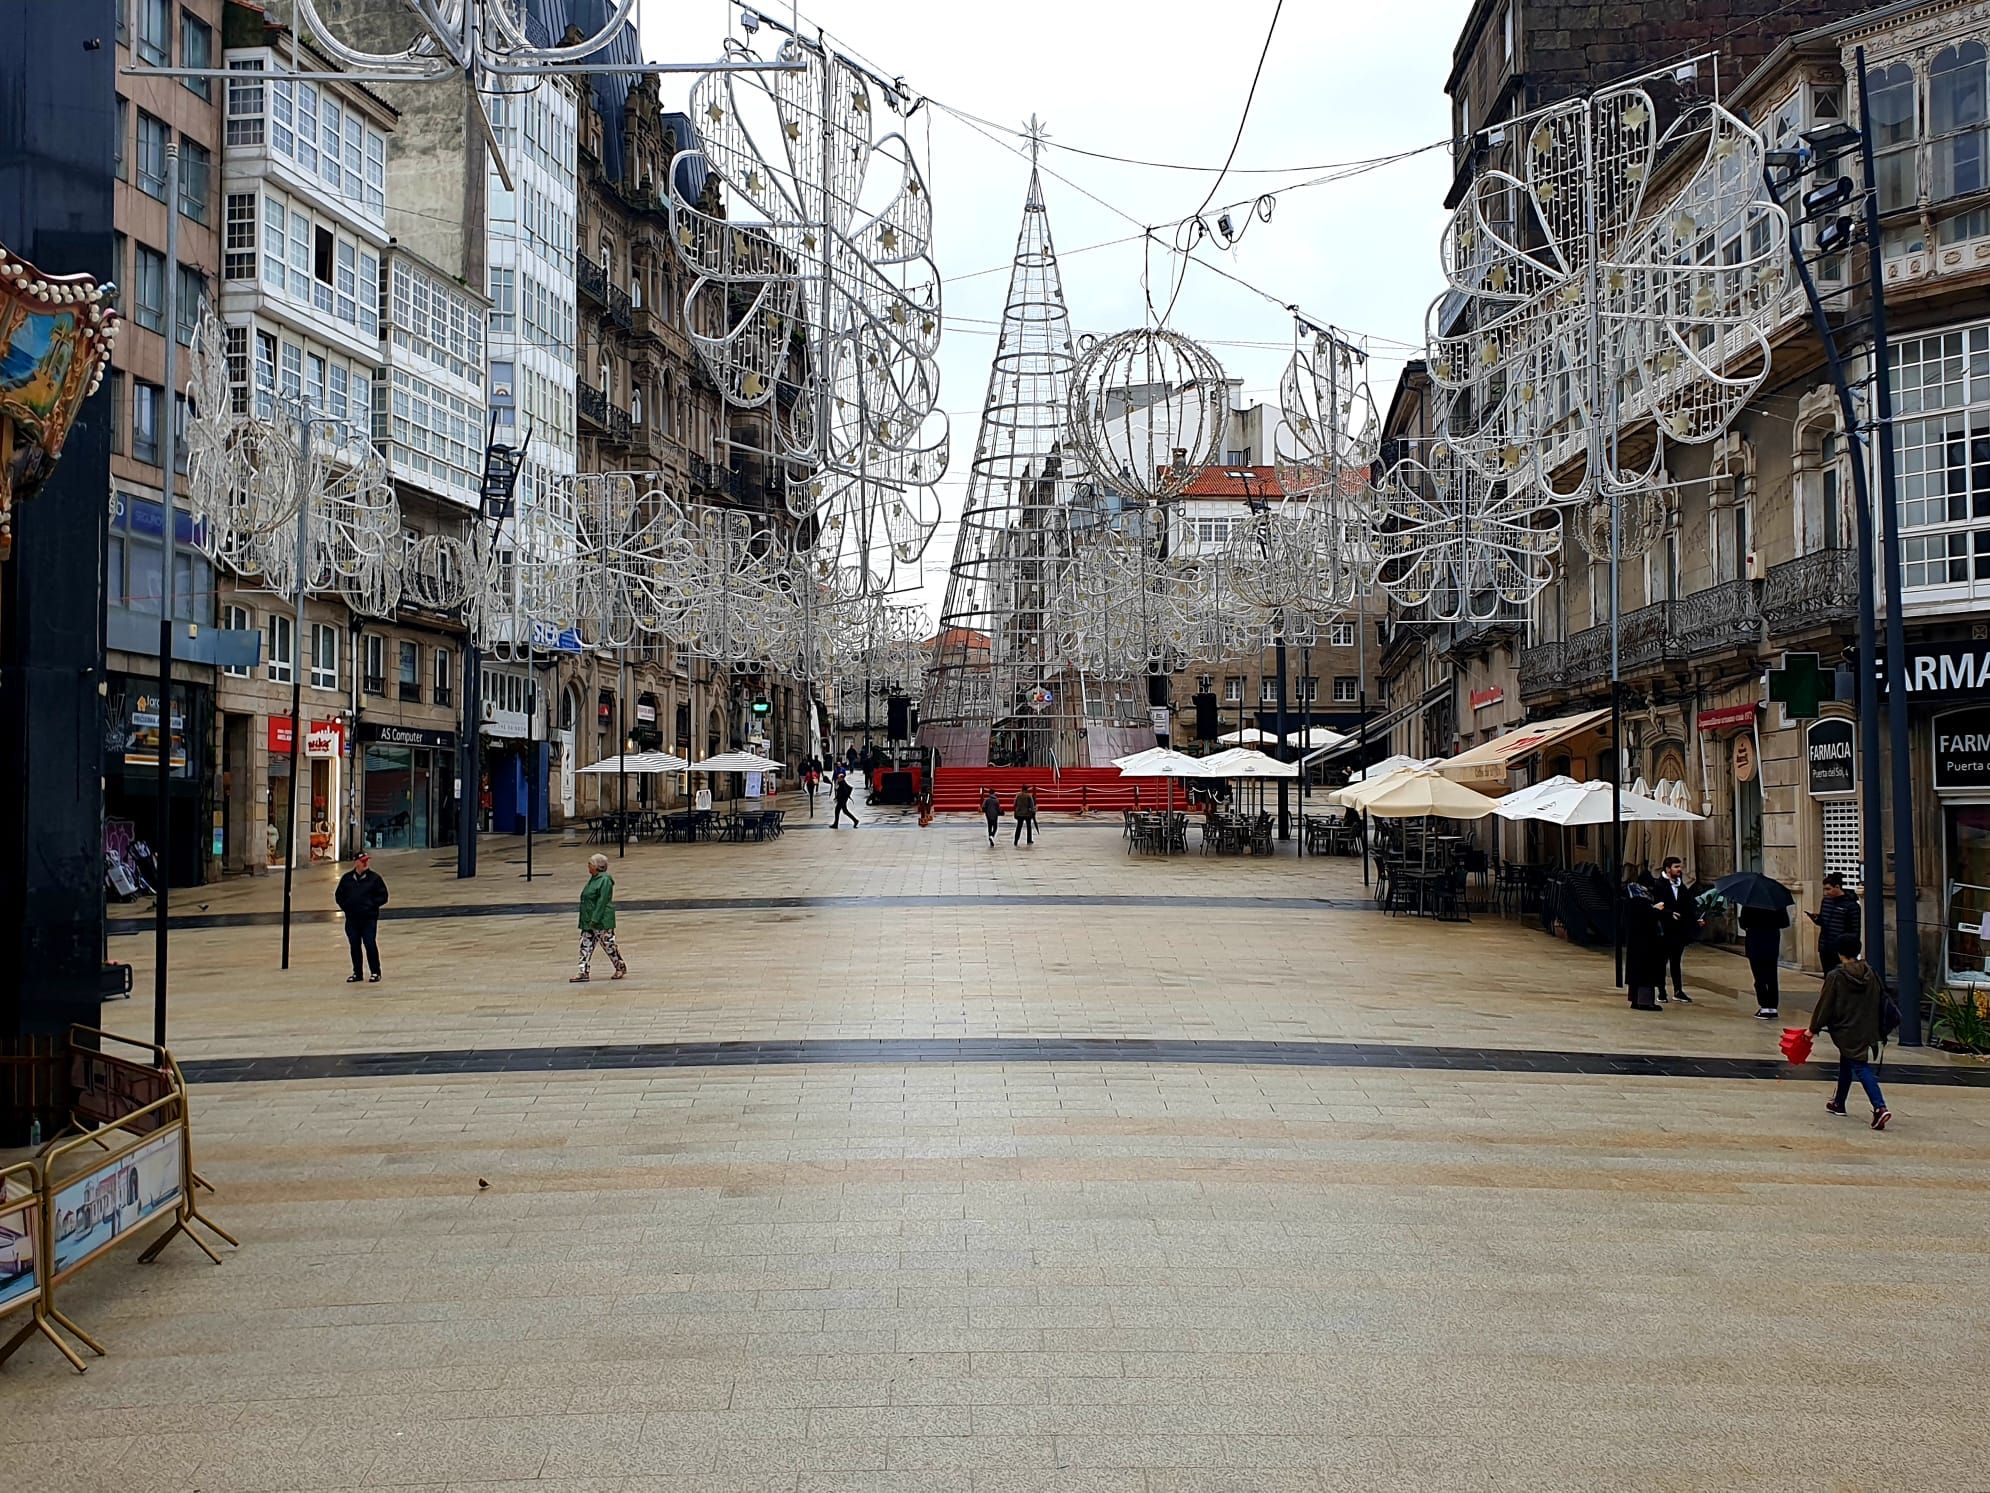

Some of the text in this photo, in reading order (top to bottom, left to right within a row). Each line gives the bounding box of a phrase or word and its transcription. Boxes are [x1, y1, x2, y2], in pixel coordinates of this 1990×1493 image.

[380, 727, 423, 744] AS Computer
[1809, 742, 1851, 761] FARMACIA
[1947, 761, 1984, 772] Puerta
